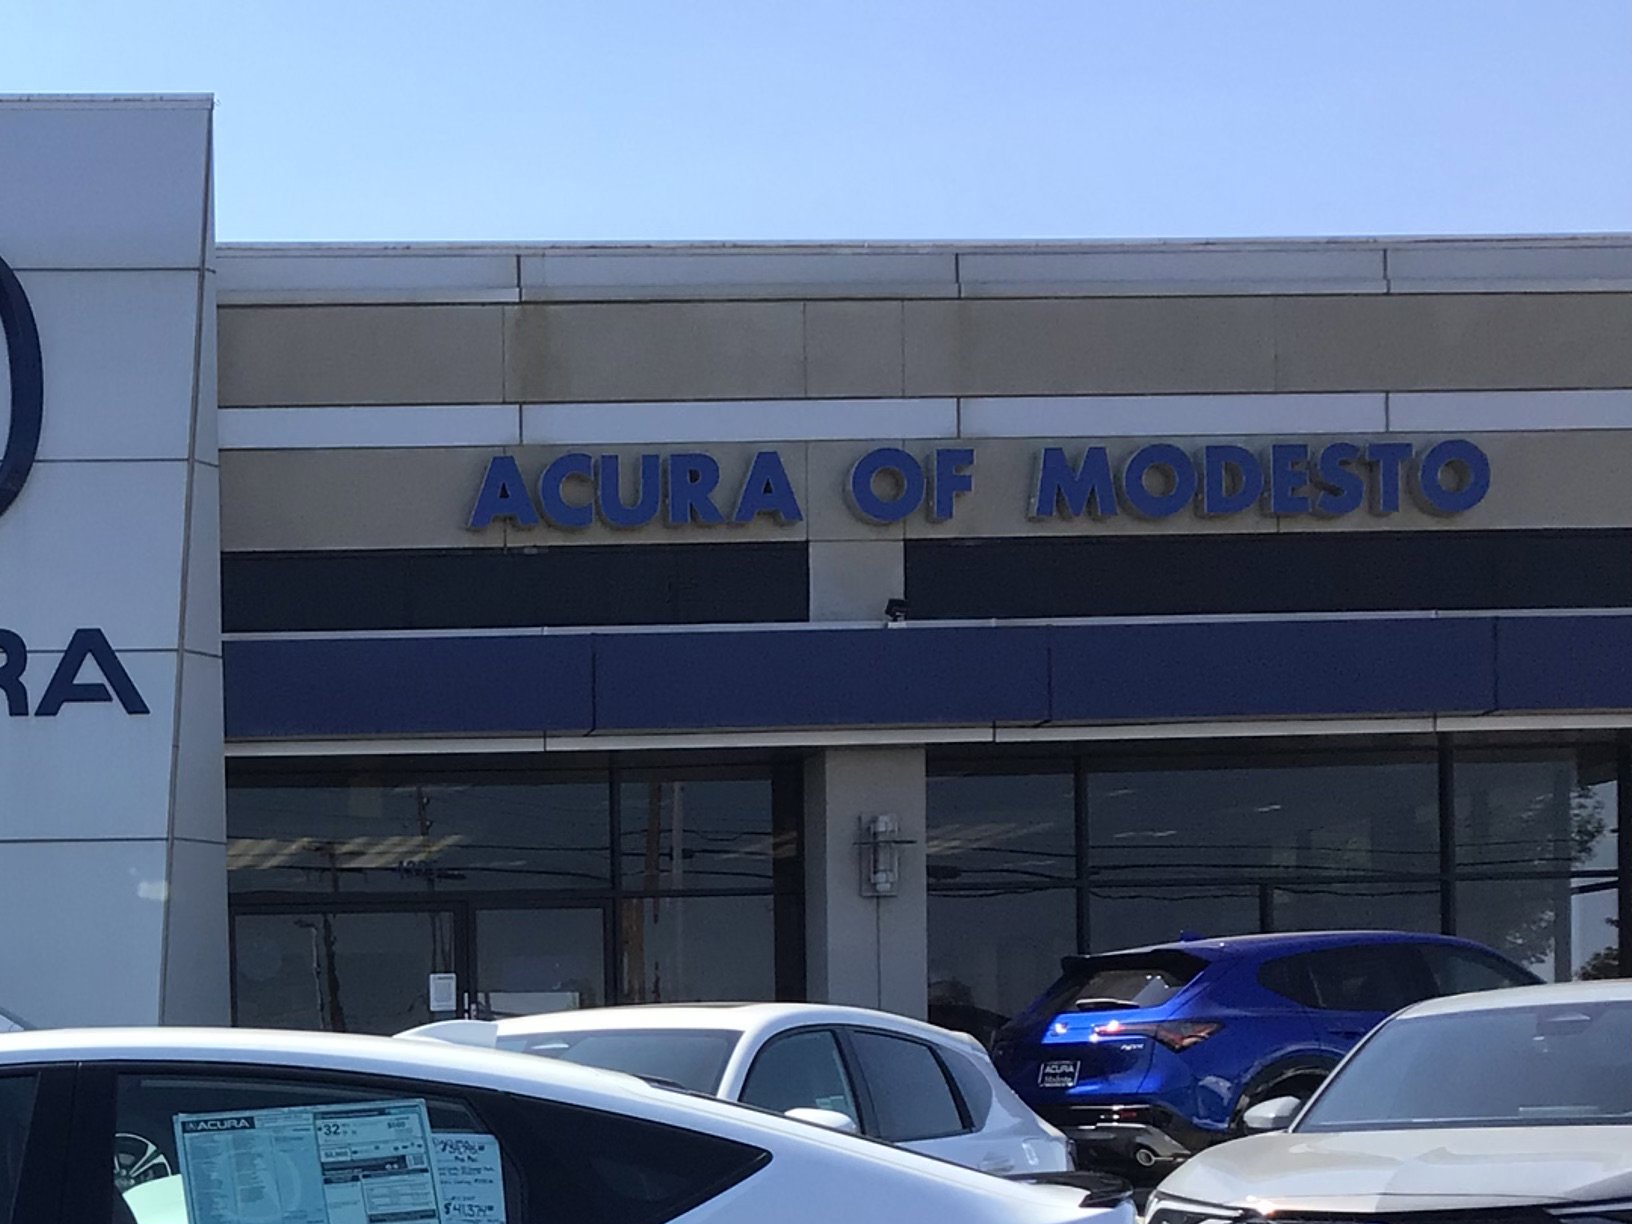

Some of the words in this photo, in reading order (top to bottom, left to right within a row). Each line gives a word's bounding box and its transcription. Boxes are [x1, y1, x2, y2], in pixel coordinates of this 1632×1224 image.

[468, 450, 804, 529] ACURA
[848, 447, 976, 523] OF
[1030, 438, 1492, 520] MODESTO
[197, 1118, 250, 1131] ACURA
[323, 1123, 341, 1137] 32
